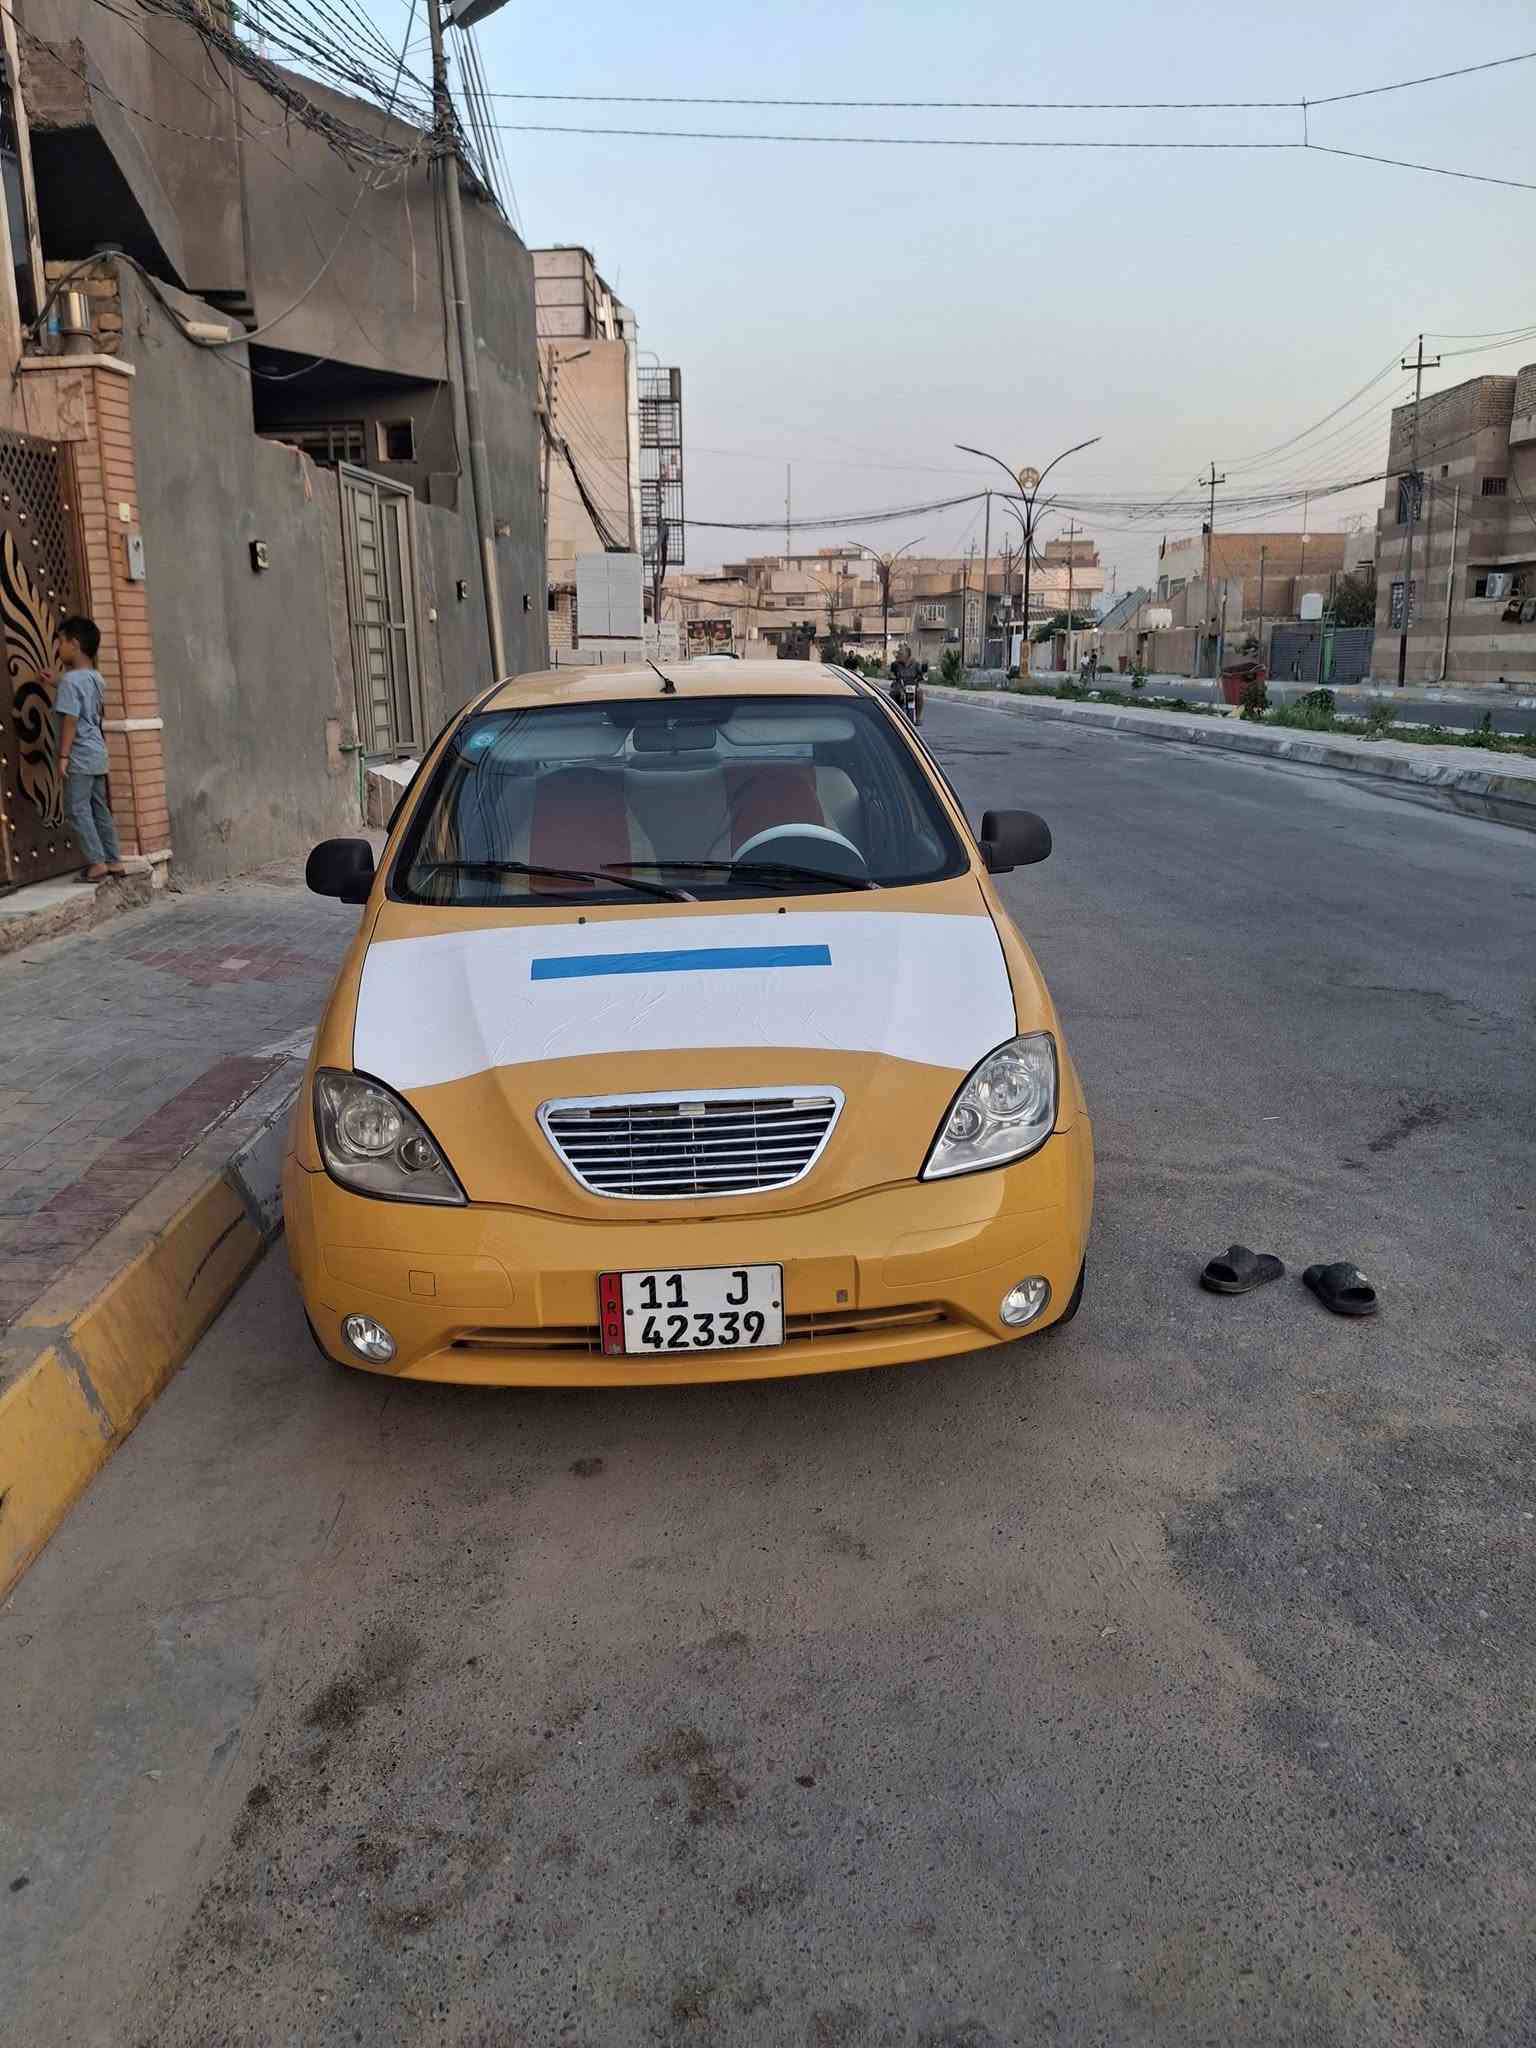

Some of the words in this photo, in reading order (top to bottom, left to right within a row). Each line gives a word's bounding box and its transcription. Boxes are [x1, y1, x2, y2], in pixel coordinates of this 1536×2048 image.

[639, 1274, 689, 1310] 11
[726, 1270, 749, 1305] J
[641, 1310, 765, 1349] 42339
